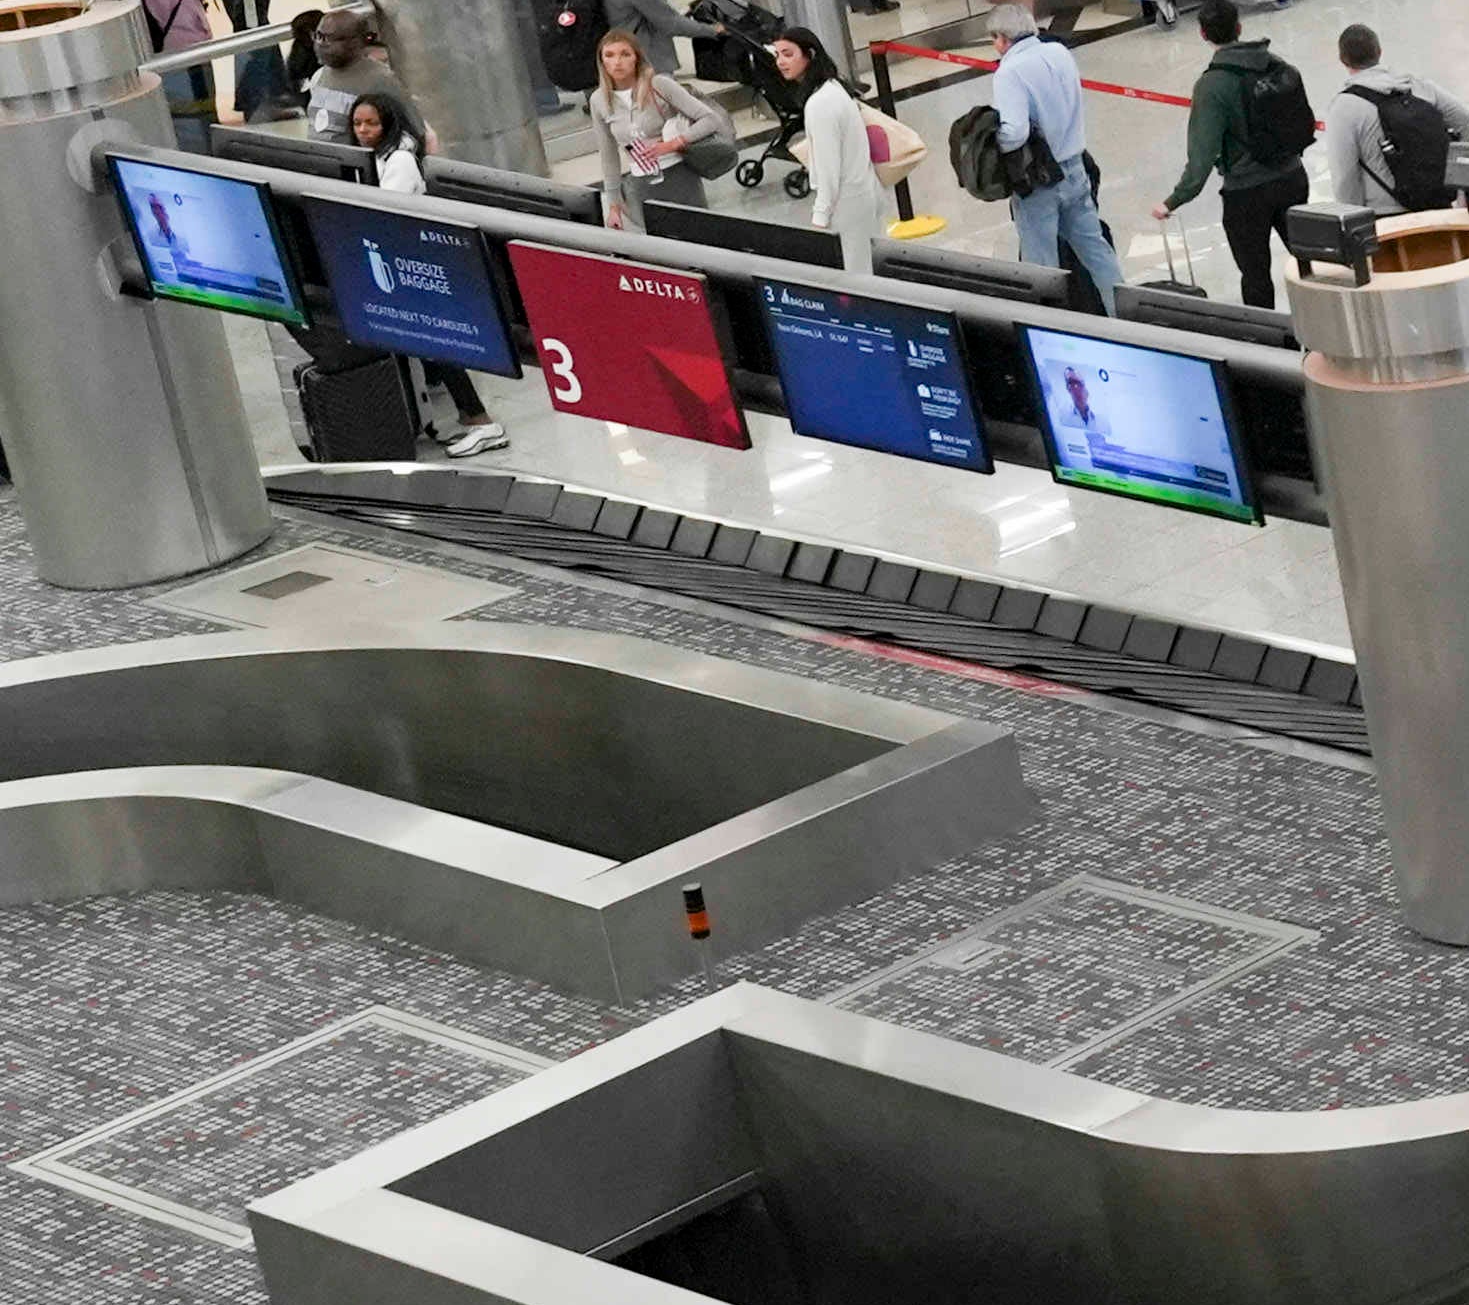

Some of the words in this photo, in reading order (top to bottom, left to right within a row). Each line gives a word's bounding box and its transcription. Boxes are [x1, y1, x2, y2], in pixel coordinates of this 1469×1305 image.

[430, 231, 461, 247] DELTA
[395, 256, 447, 280] OVERSIZE
[399, 271, 453, 295] BAGGAGE
[634, 278, 687, 301] DELTA
[764, 286, 775, 303] 3
[541, 337, 584, 404] 3
